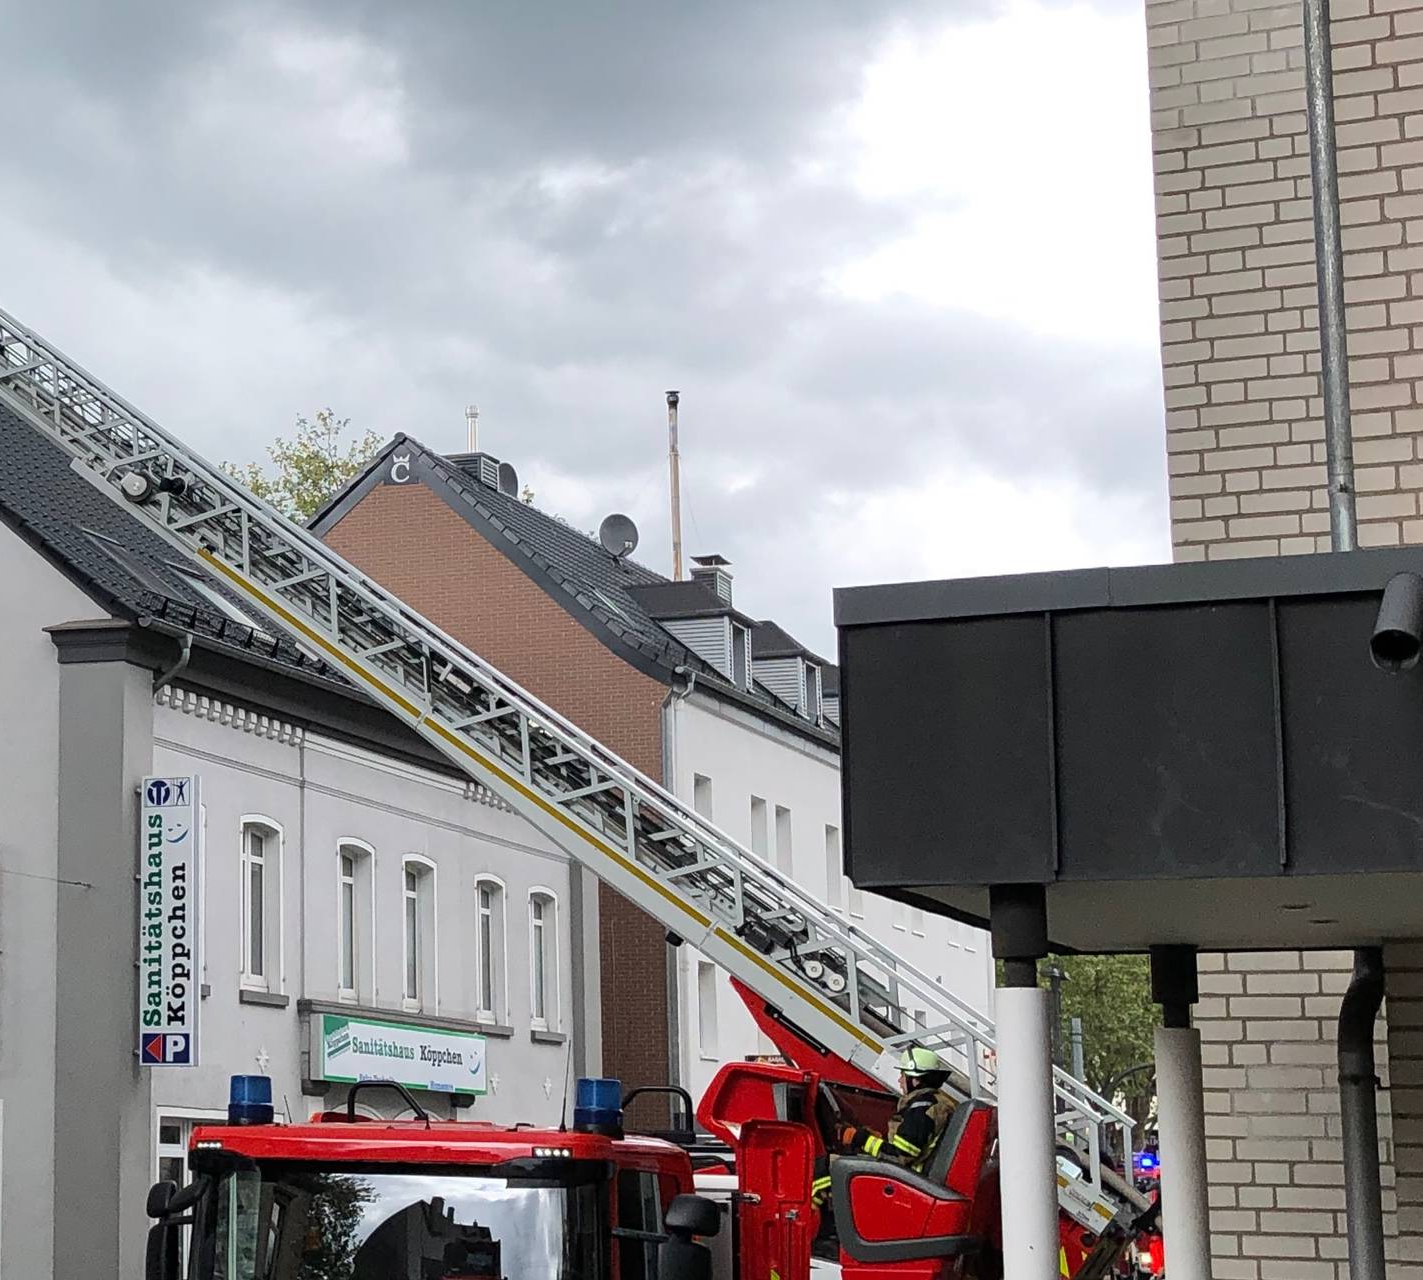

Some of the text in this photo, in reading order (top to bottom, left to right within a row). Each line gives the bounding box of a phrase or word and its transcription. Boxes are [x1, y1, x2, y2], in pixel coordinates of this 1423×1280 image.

[391, 462, 410, 483] C
[142, 813, 163, 1027] Sanitätshaus
[166, 862, 191, 1027] Köppchen
[165, 1035, 187, 1062] P
[352, 1036, 415, 1061] Sanitätshaus
[419, 1044, 464, 1067] Köppchen
